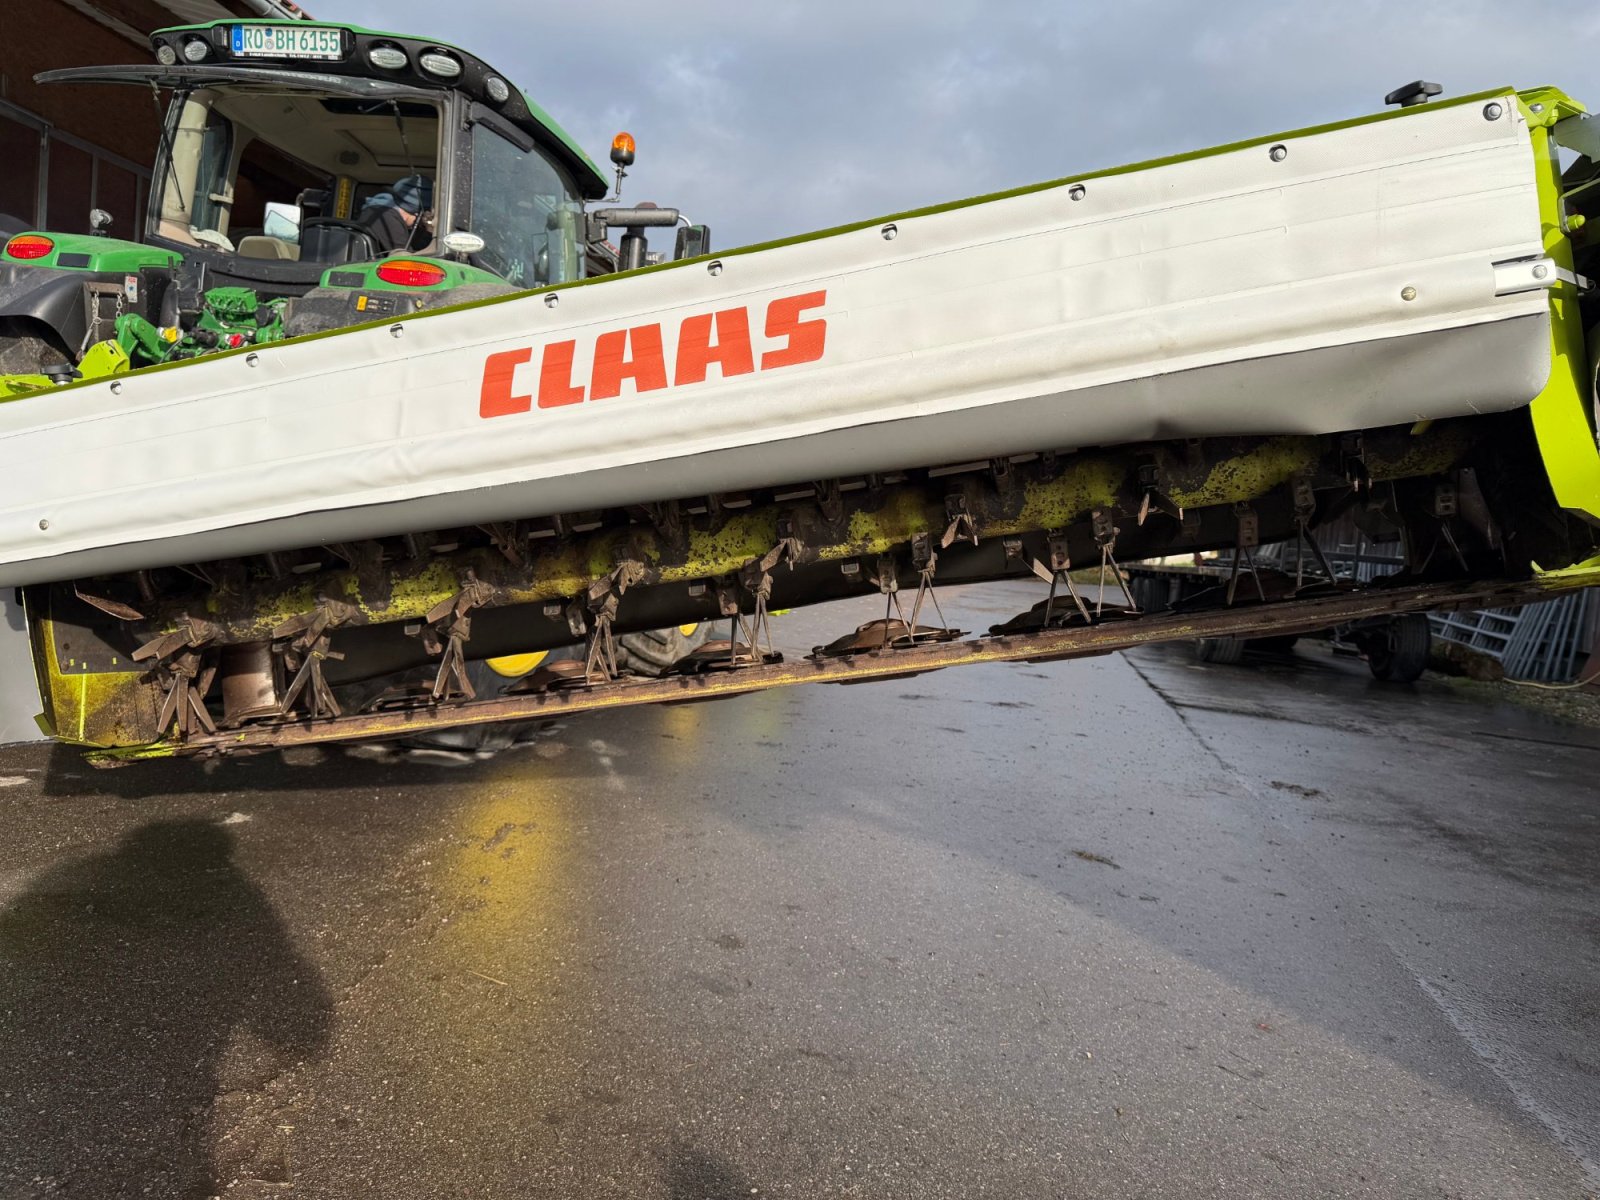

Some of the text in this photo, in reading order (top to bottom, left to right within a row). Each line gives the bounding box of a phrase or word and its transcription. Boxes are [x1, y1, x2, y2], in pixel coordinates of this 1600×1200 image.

[244, 28, 264, 49] RO
[275, 29, 296, 50] BH
[300, 30, 339, 52] 6155
[479, 289, 827, 419] CLAAS
